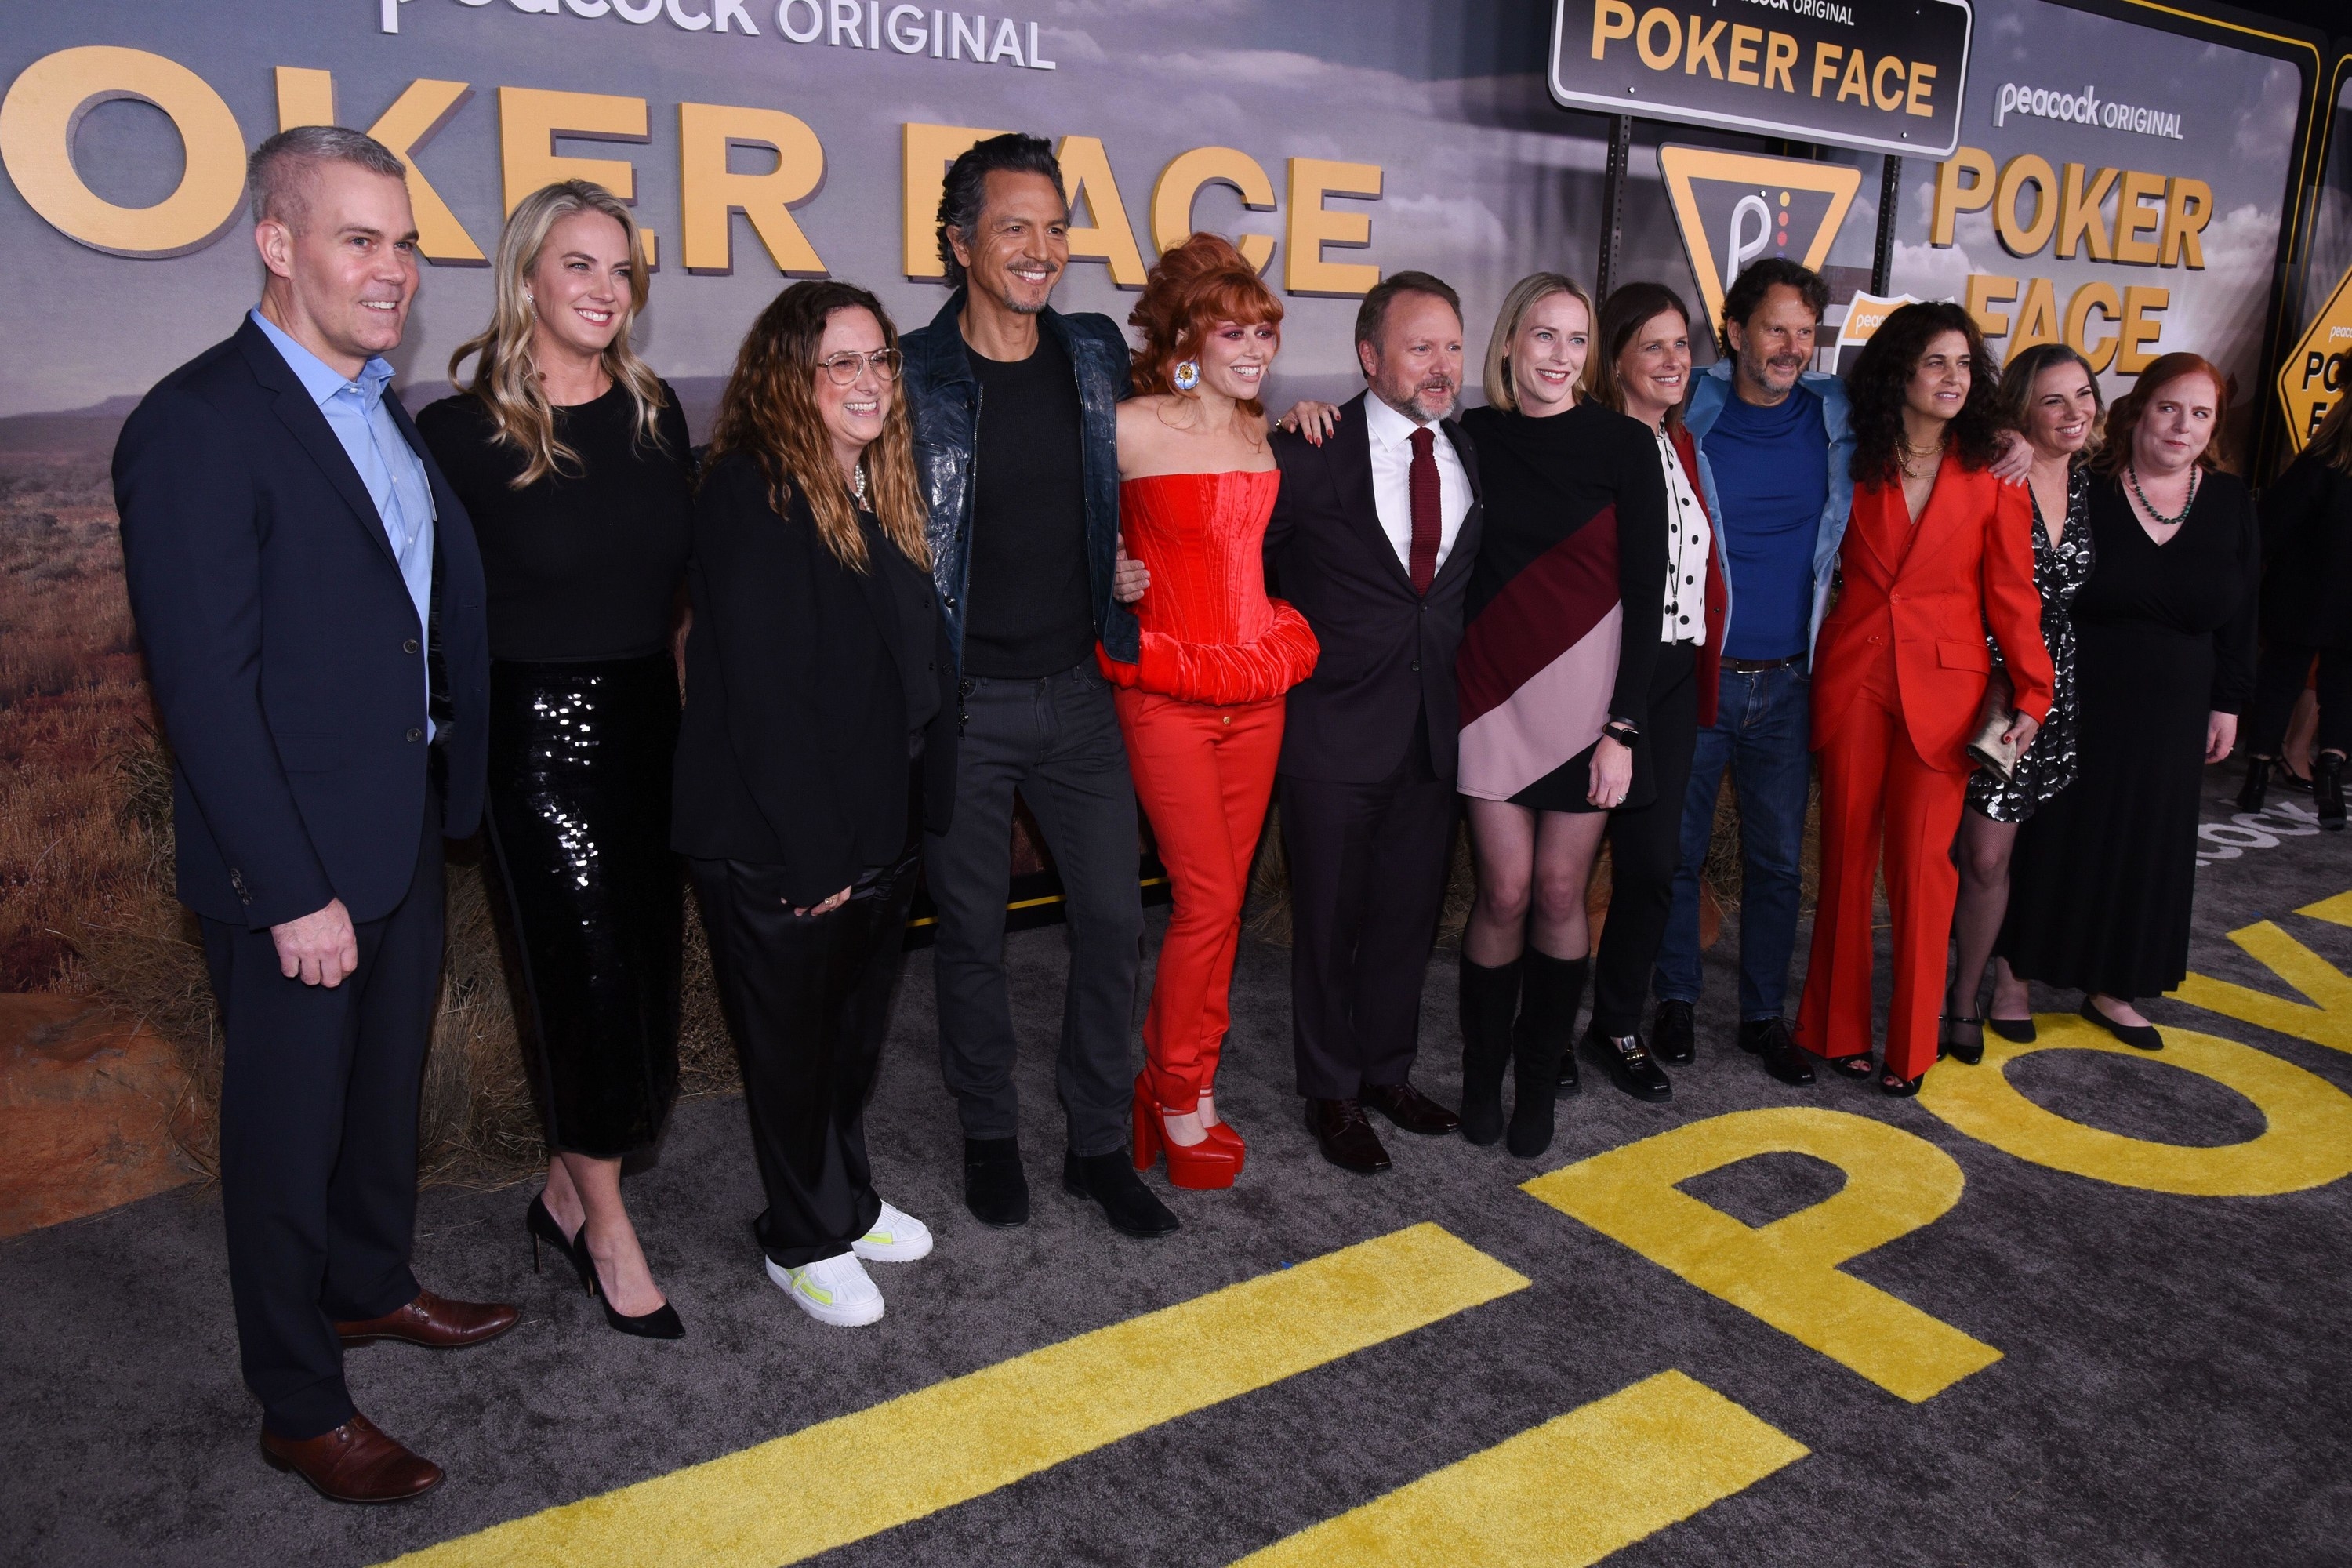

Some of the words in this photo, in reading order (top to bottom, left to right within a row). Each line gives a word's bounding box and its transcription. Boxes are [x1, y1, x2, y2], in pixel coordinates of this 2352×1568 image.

[775, 0, 1057, 70] ORIGINAL
[1591, 0, 1798, 93] POKER
[1811, 42, 1937, 118] FACE
[1792, 0, 1855, 26] ORIGINAL
[1994, 82, 2100, 128] peacock
[2102, 102, 2183, 140] ORIGINAL
[902, 122, 1382, 296] FACE
[1931, 147, 2213, 270] POKER
[1965, 274, 2170, 376] FACE
